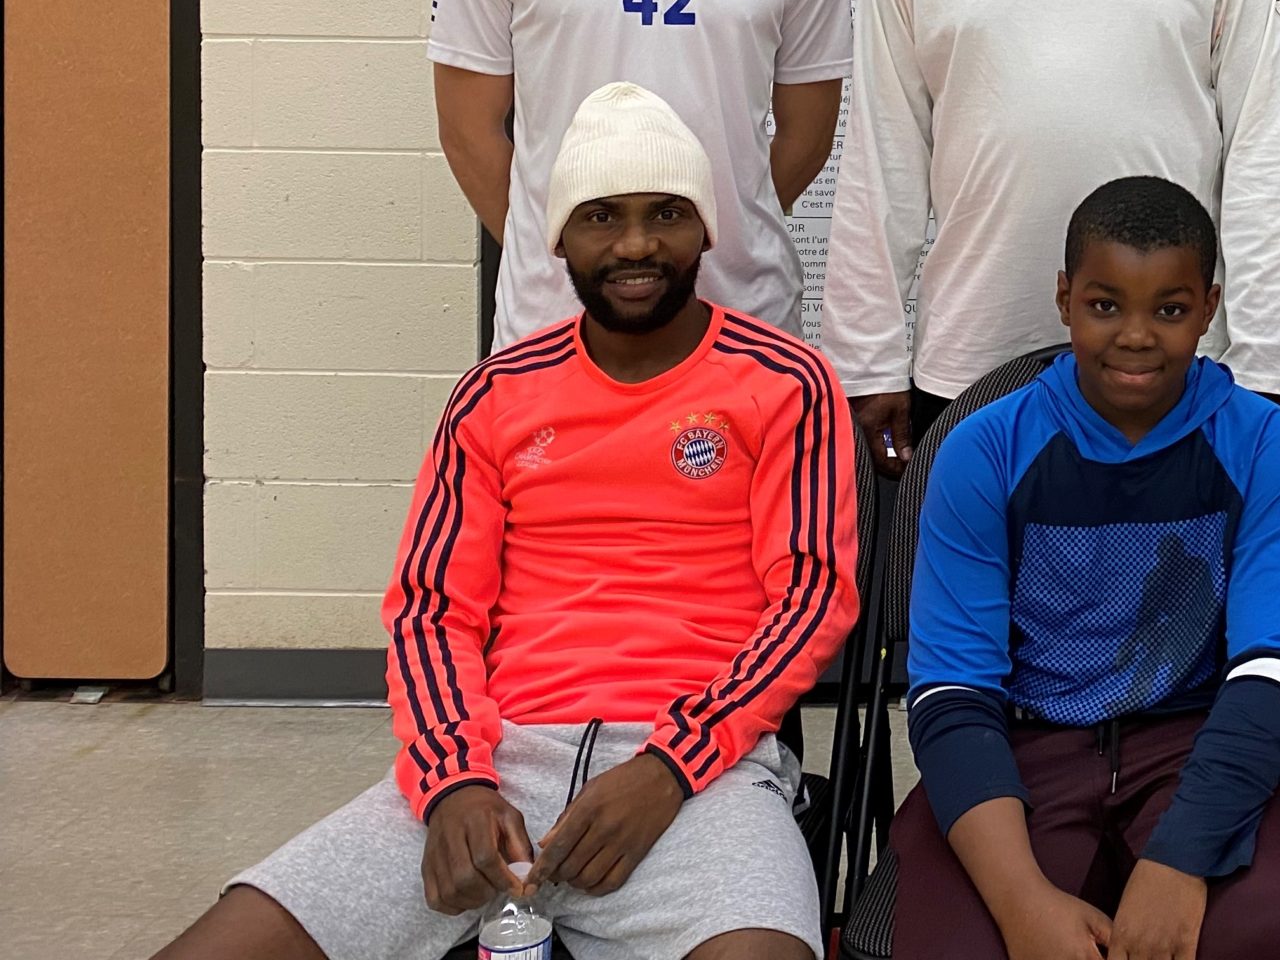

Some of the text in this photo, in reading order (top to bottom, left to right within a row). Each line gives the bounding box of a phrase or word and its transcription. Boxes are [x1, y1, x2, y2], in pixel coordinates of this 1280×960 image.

[801, 200, 823, 209] C'est
[676, 429, 725, 450] FC BAYERN
